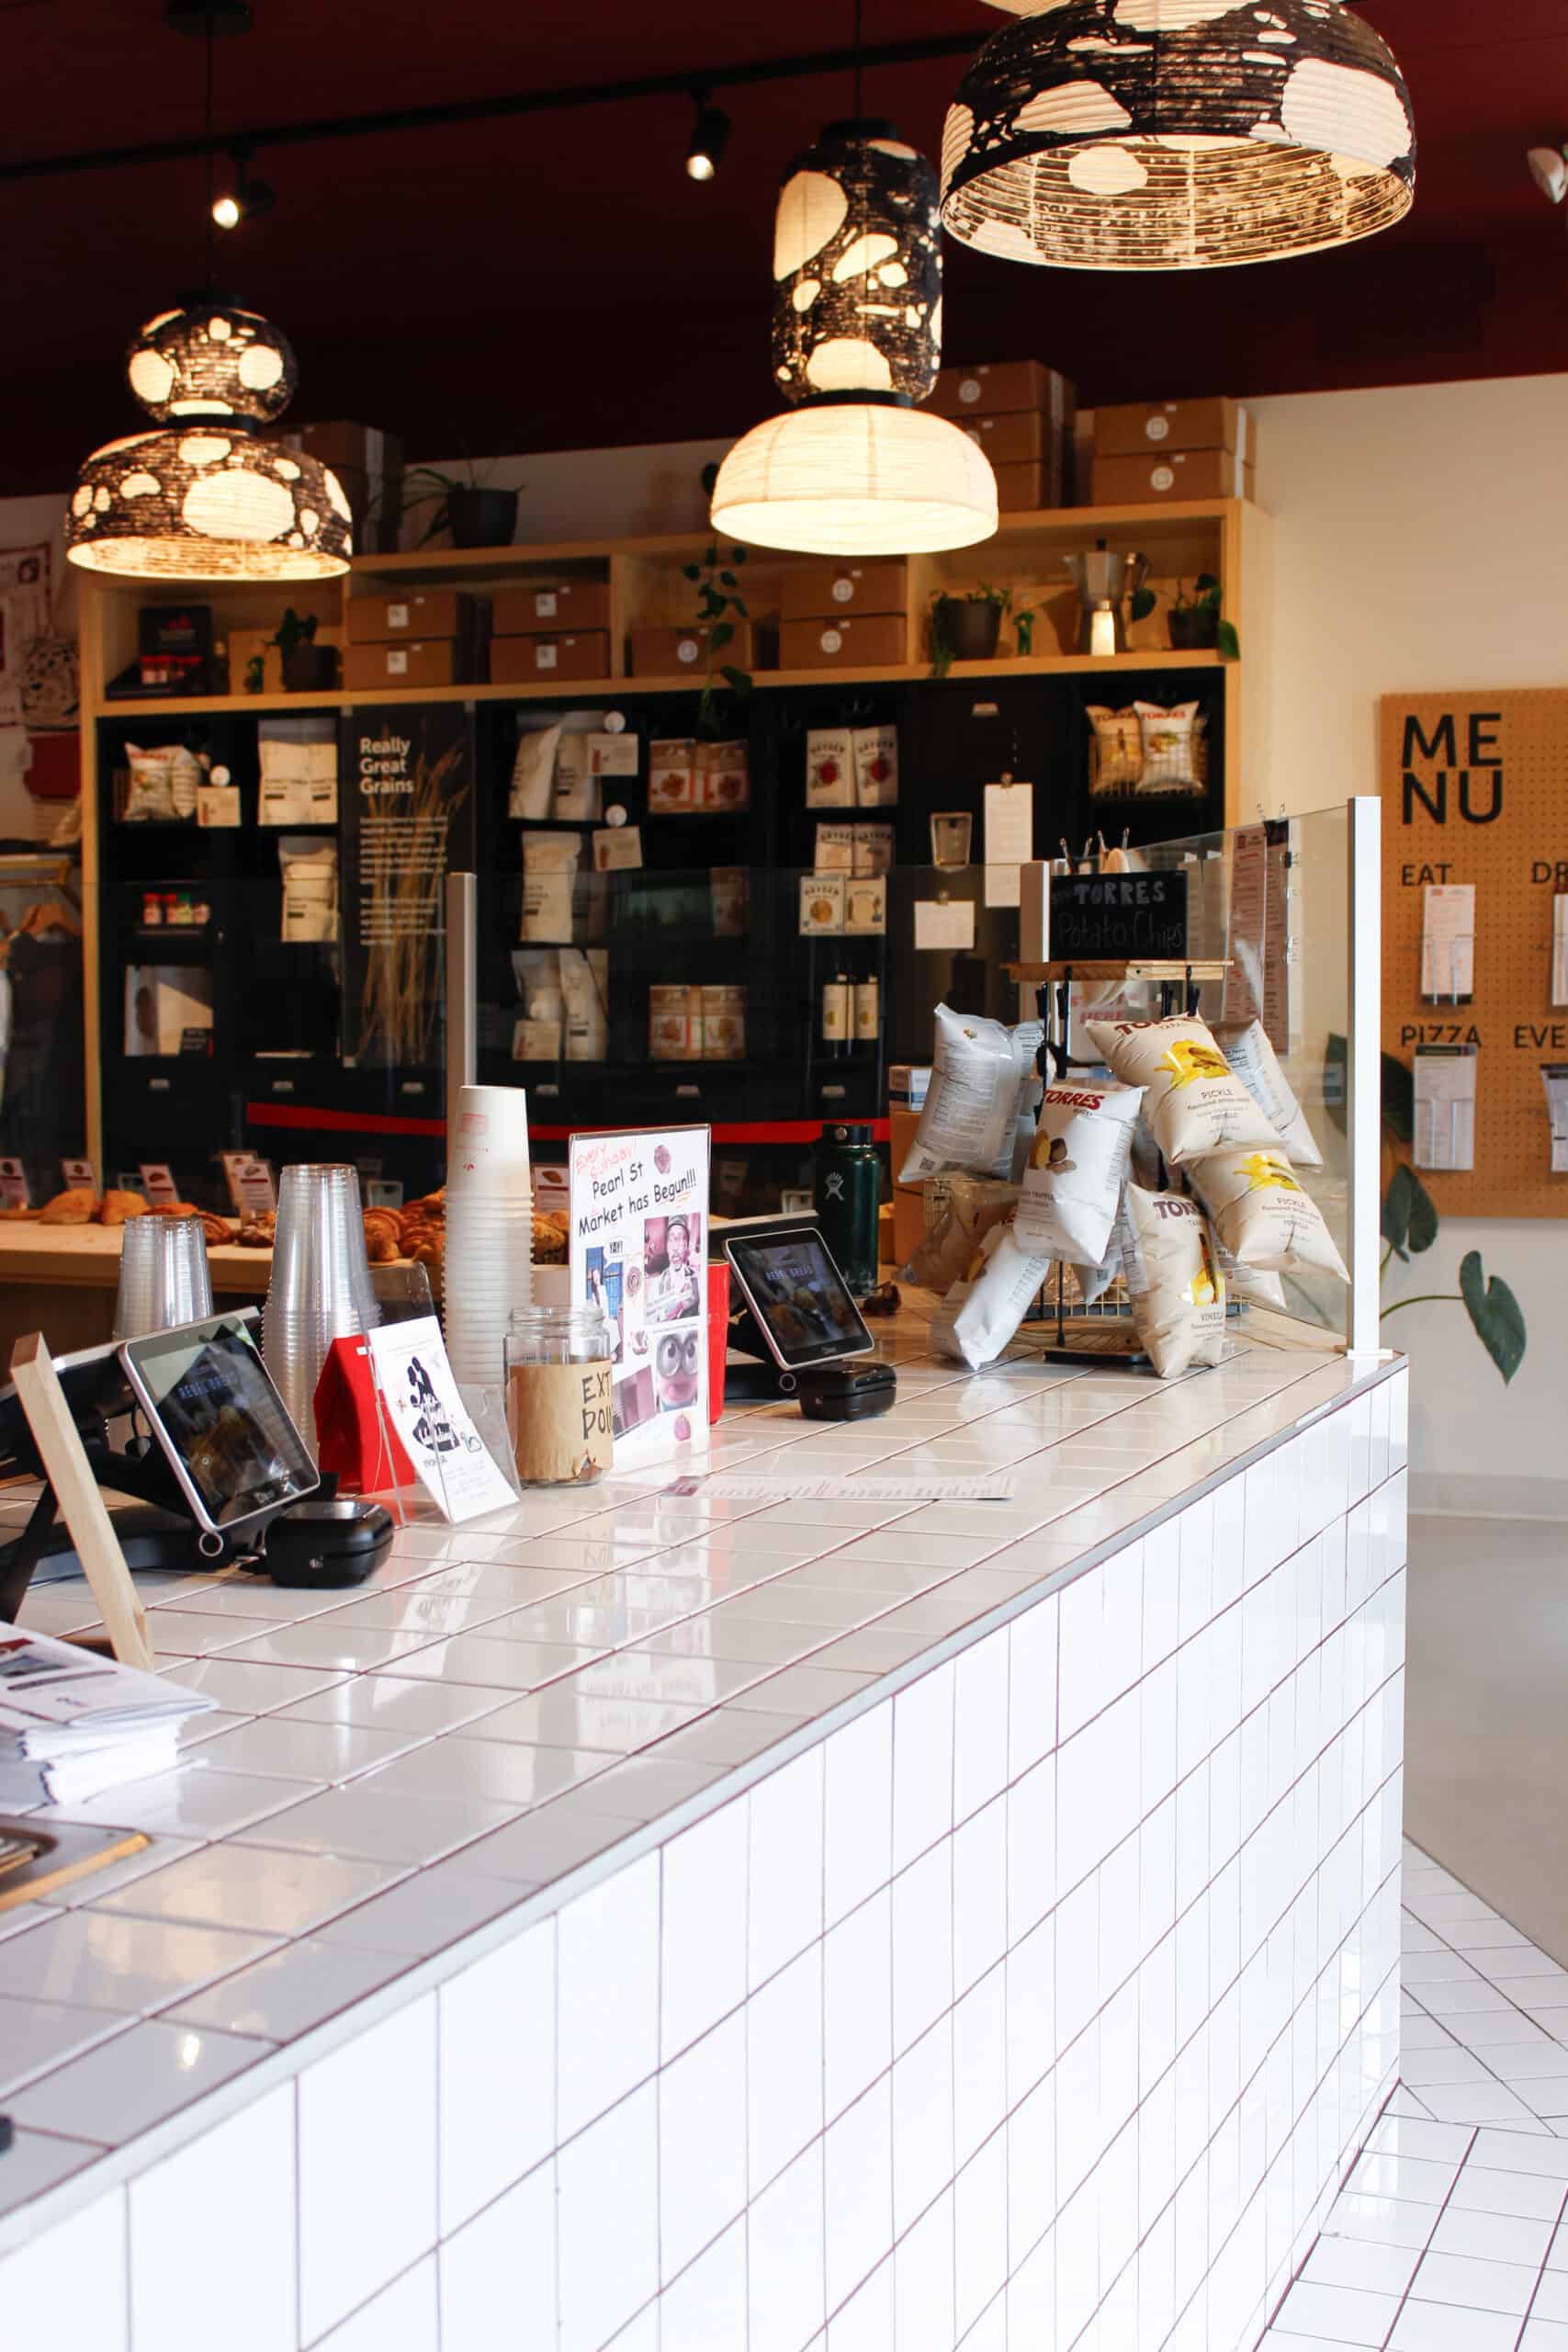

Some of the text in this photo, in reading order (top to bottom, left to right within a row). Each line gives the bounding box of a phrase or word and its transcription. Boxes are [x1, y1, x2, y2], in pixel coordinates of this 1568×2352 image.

[360, 738, 411, 757] Really
[1402, 713, 1503, 769] ME
[360, 758, 407, 775] Great
[360, 777, 413, 796] Grains
[1403, 770, 1503, 825] NU
[1402, 862, 1453, 887] EAT
[1073, 880, 1167, 906] TORRES
[1401, 1023, 1483, 1048] PIZZA
[1043, 1089, 1106, 1111] TORRES
[592, 1161, 644, 1199] Pearl St
[579, 1168, 697, 1237] Market has Begun!!!
[609, 1240, 624, 1255] YAY!
